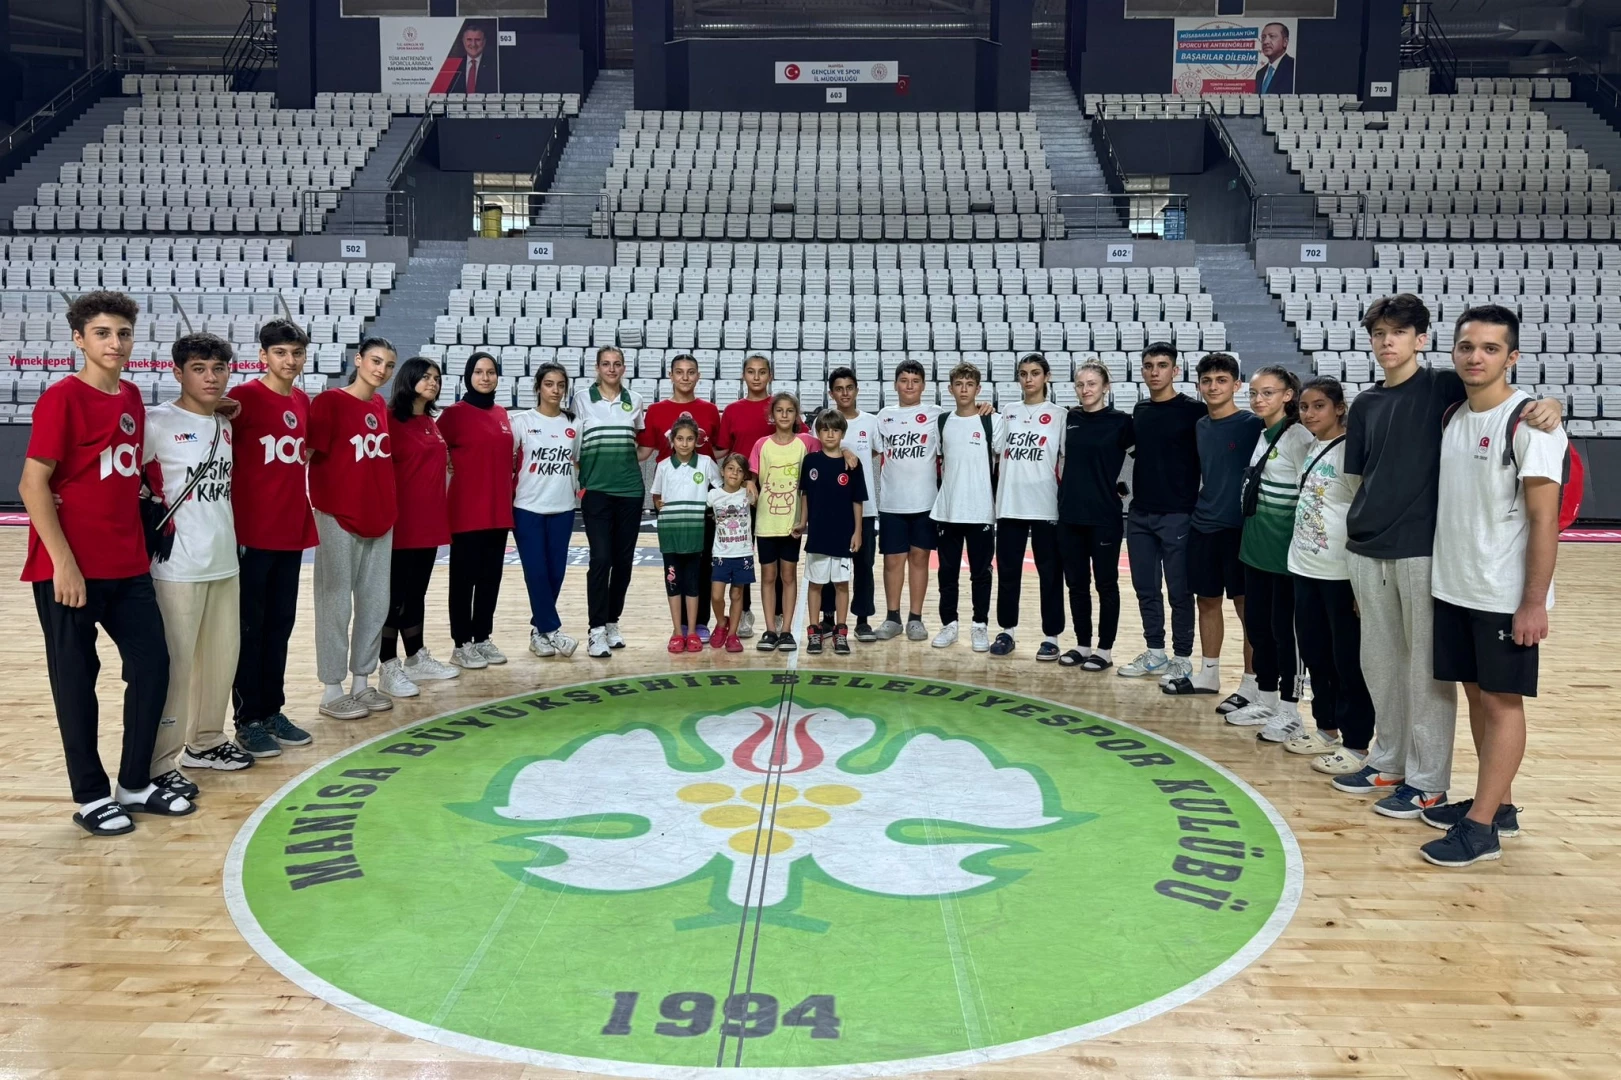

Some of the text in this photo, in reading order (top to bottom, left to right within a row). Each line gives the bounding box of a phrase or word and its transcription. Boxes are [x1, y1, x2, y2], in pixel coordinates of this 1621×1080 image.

[1181, 52, 1258, 62] BAŞARILAR DİLERİM.
[345, 245, 361, 253] 502
[533, 247, 549, 255] 602
[1112, 249, 1127, 257] 602
[1305, 249, 1321, 257] 702
[531, 445, 572, 462] MESİR
[892, 445, 927, 460] KARATE
[1007, 447, 1045, 462] KARATE
[284, 672, 1265, 912] MANİSA BÜYÜKŞEHİR BELEDİYESPOR KULÜBÜ
[601, 991, 841, 1039] 1994
